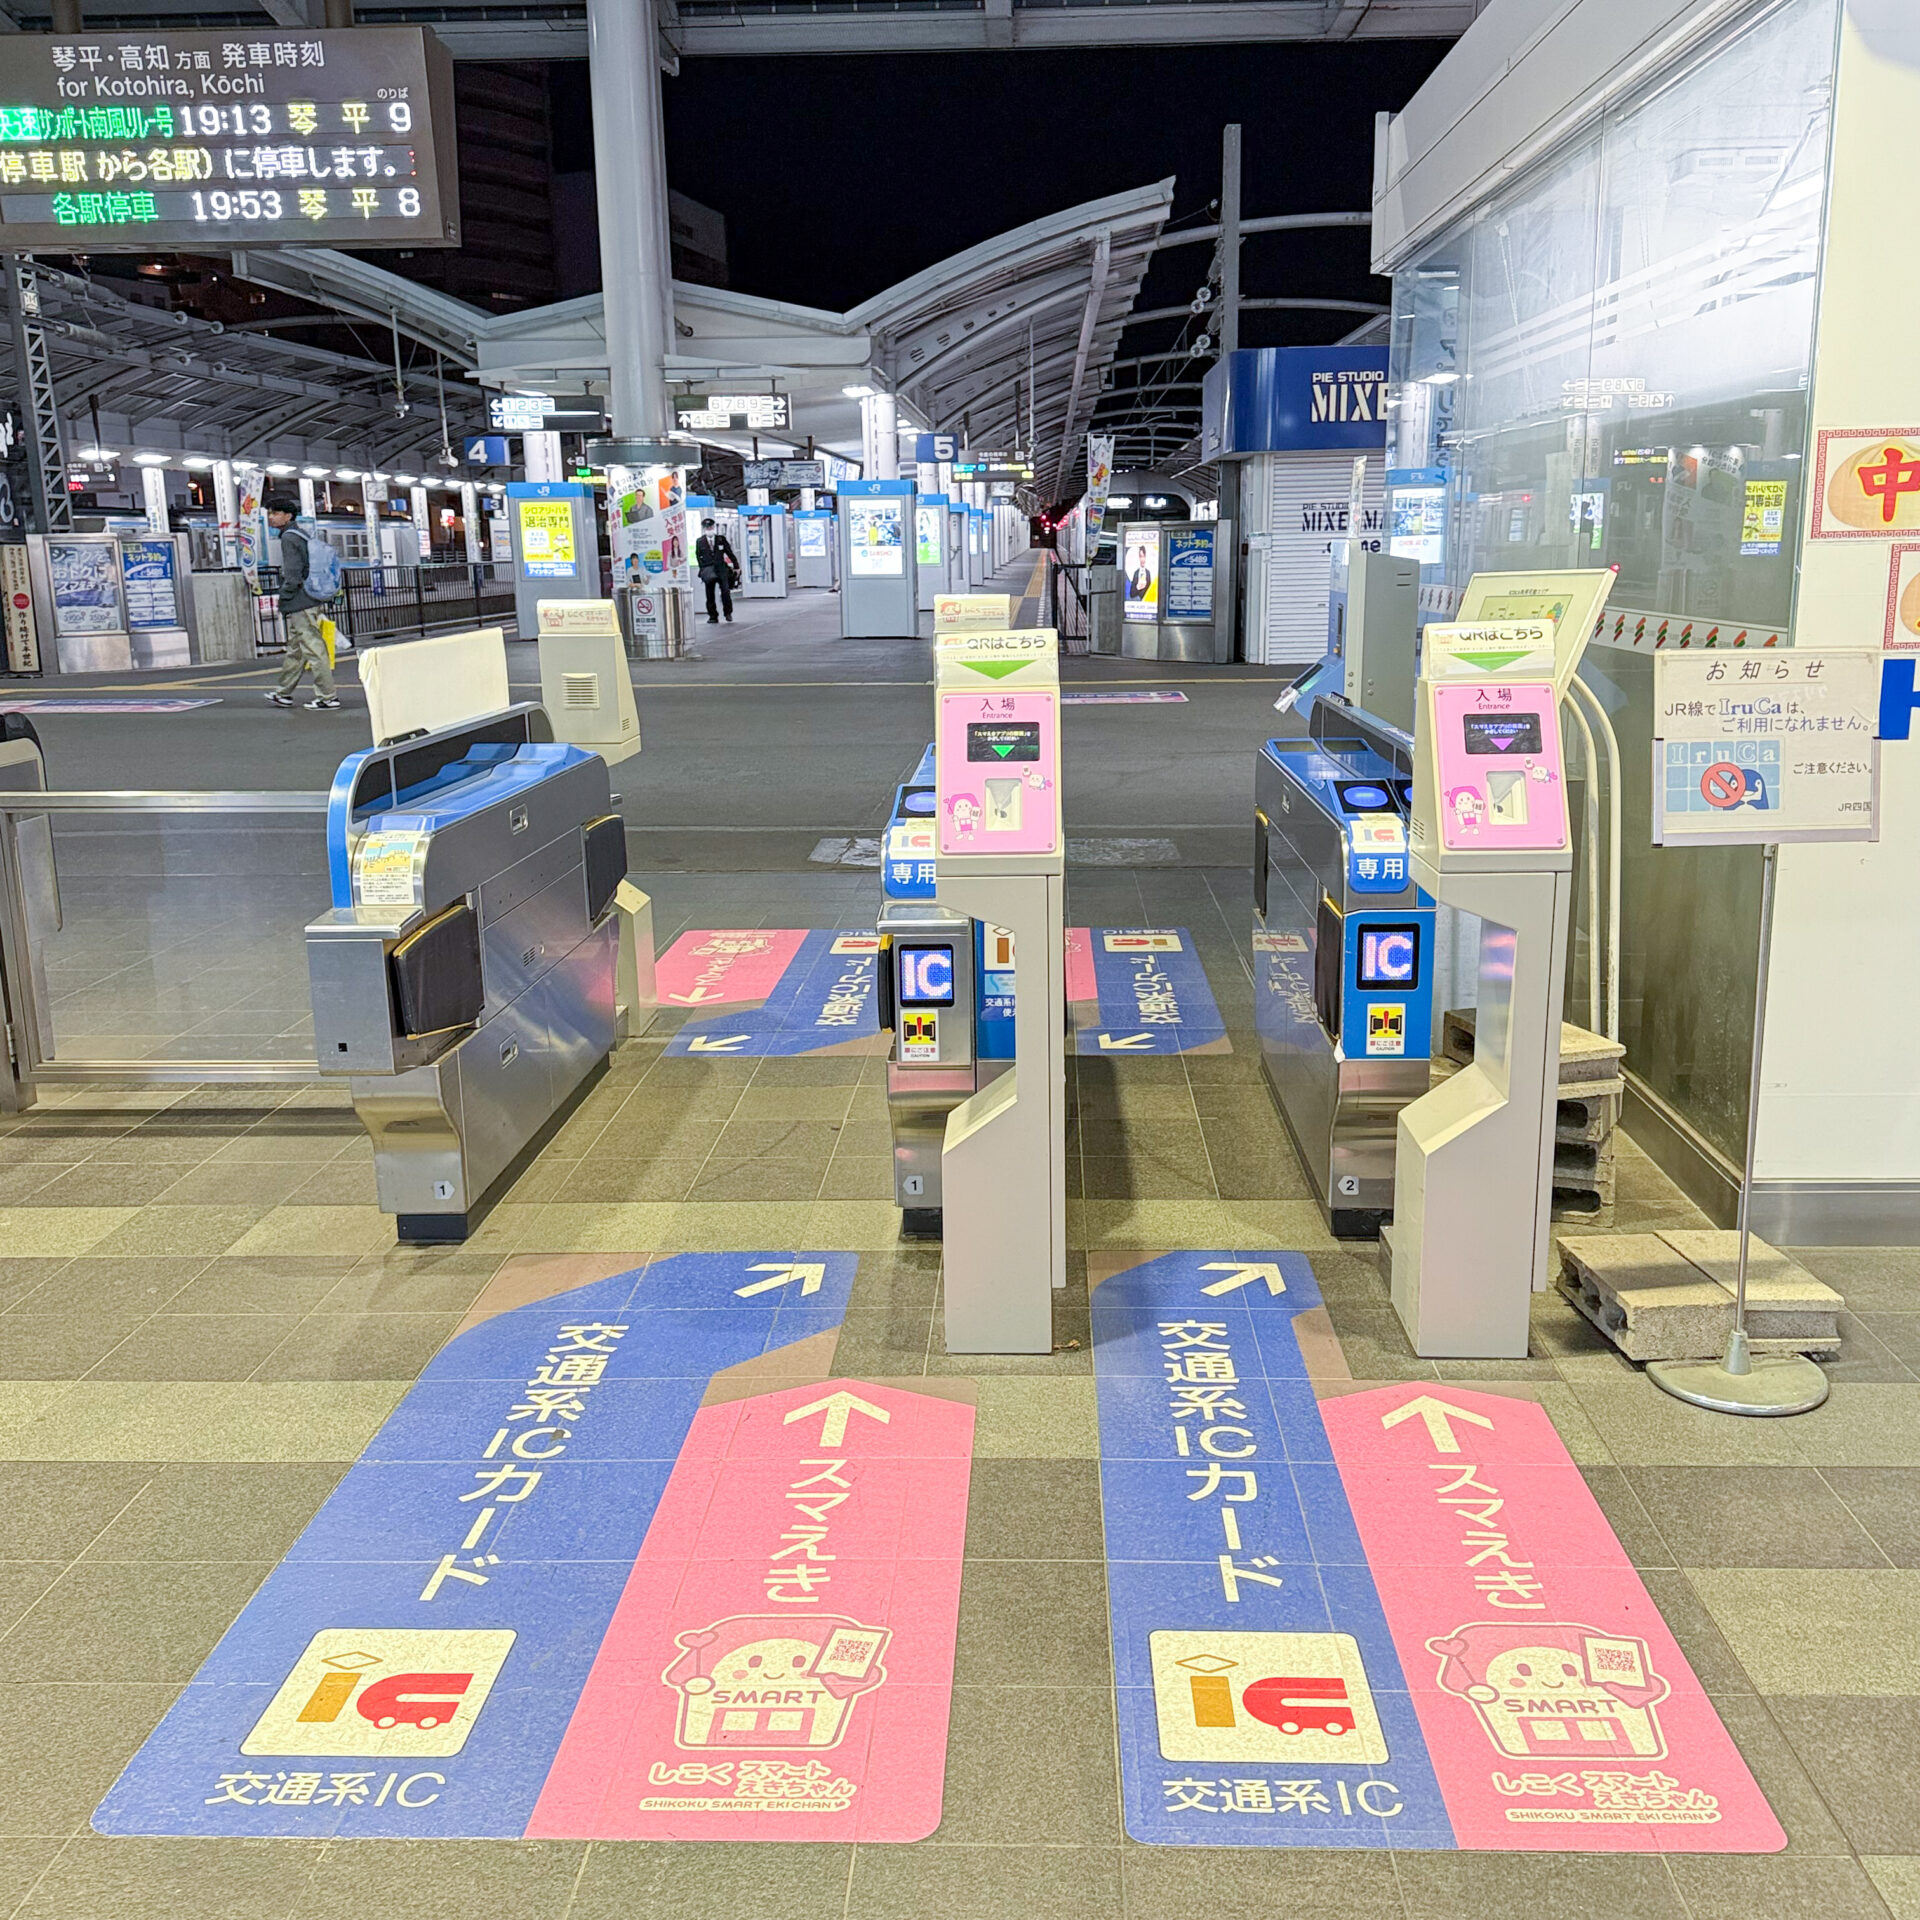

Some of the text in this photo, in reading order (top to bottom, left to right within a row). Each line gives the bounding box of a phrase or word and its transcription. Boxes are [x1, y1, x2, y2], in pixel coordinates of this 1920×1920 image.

[51, 40, 325, 72] 琴平・高知 方面 発車時刻
[57, 73, 265, 98] for Kotohira, Kōchi
[377, 87, 408, 99] のりば
[180, 104, 271, 135] 19:13
[389, 102, 412, 132] 9
[0, 150, 88, 183] 停車駅
[225, 146, 396, 179] に停車します。
[52, 190, 159, 225] 各駅停車
[192, 190, 282, 221] 19:53
[398, 188, 420, 217] 8
[1312, 371, 1384, 383] PIE STUDIO
[468, 440, 488, 463] 4
[934, 436, 954, 460] 5
[868, 483, 881, 491] JR
[1858, 448, 1920, 523] 中
[598, 499, 608, 510] J
[816, 496, 825, 506] 4
[1302, 503, 1318, 511] PIE
[525, 516, 569, 528] 退治専門
[967, 635, 1046, 650] QRはこちら
[1705, 659, 1825, 681] お知らせ
[980, 698, 1015, 711] 入場
[1476, 688, 1512, 702] 入場
[1478, 702, 1510, 710] Entrance
[1721, 717, 1869, 734] ご利用になれません。
[1671, 742, 1776, 764] IruCa
[1792, 762, 1872, 775] ご注意ください。
[1838, 801, 1872, 813] JR四国
[891, 862, 936, 885] 専用
[1356, 857, 1403, 880] 専用
[1364, 934, 1412, 980] IC
[903, 953, 952, 997] IC
[814, 957, 873, 1026] 交通系ICカード
[1129, 955, 1183, 1024] 交通系ICカード
[440, 1184, 446, 1196] 1
[911, 1179, 918, 1191] 1
[1346, 1179, 1355, 1191] 2
[418, 1322, 630, 1601] 交通系ICカード
[1157, 1319, 1284, 1602] 交通系ICカード
[763, 1459, 853, 1603] スマえき
[1428, 1464, 1546, 1610] スマえき
[711, 1690, 826, 1704] SMART
[1503, 1699, 1618, 1714] SMART
[738, 1760, 831, 1780] スマート
[1580, 1770, 1680, 1790] スマート
[204, 1770, 446, 1808] 交通系IC
[735, 1777, 857, 1798] えきちゃん
[1162, 1777, 1404, 1817] 交通系IC
[643, 1799, 707, 1809] SHIKOKU
[711, 1800, 761, 1809] SMART
[1593, 1787, 1718, 1810] えきちゃん
[1510, 1810, 1576, 1820] SHIKOKU
[1580, 1811, 1631, 1821] SMART
